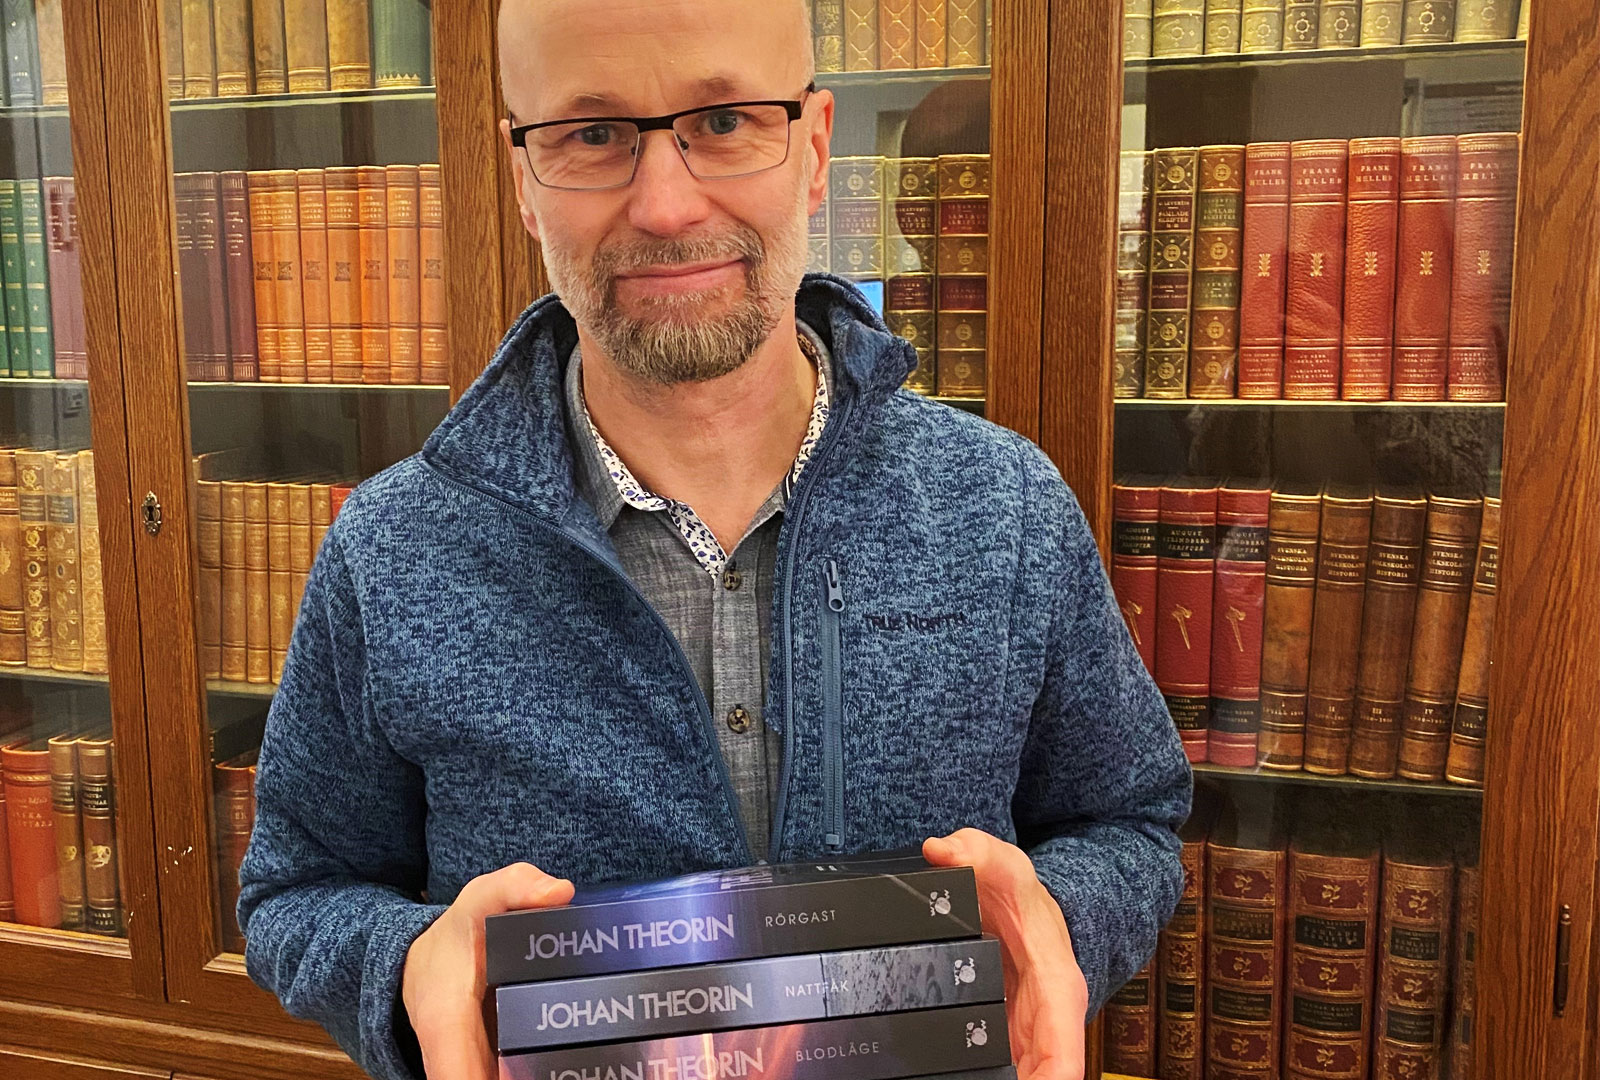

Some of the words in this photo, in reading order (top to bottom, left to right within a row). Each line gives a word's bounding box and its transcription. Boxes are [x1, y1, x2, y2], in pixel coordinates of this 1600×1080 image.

[1277, 547, 1308, 555] SVENSKA
[1330, 552, 1360, 560] SVENSKA
[1379, 552, 1410, 561] SVENSKA
[1432, 551, 1464, 559] SVENSKA
[1327, 569, 1360, 577] HISTORIA
[1375, 569, 1408, 578] HISTORIA
[765, 909, 836, 928] RÖRGAST
[524, 926, 619, 960] JOHAN
[624, 914, 735, 949] THEORIN
[785, 978, 850, 998] NATTFÅK
[537, 995, 635, 1031] JOHAN
[639, 983, 754, 1019] THEORIN
[795, 1041, 880, 1062] BLODLÄGE
[648, 1047, 765, 1080] THEORIN
